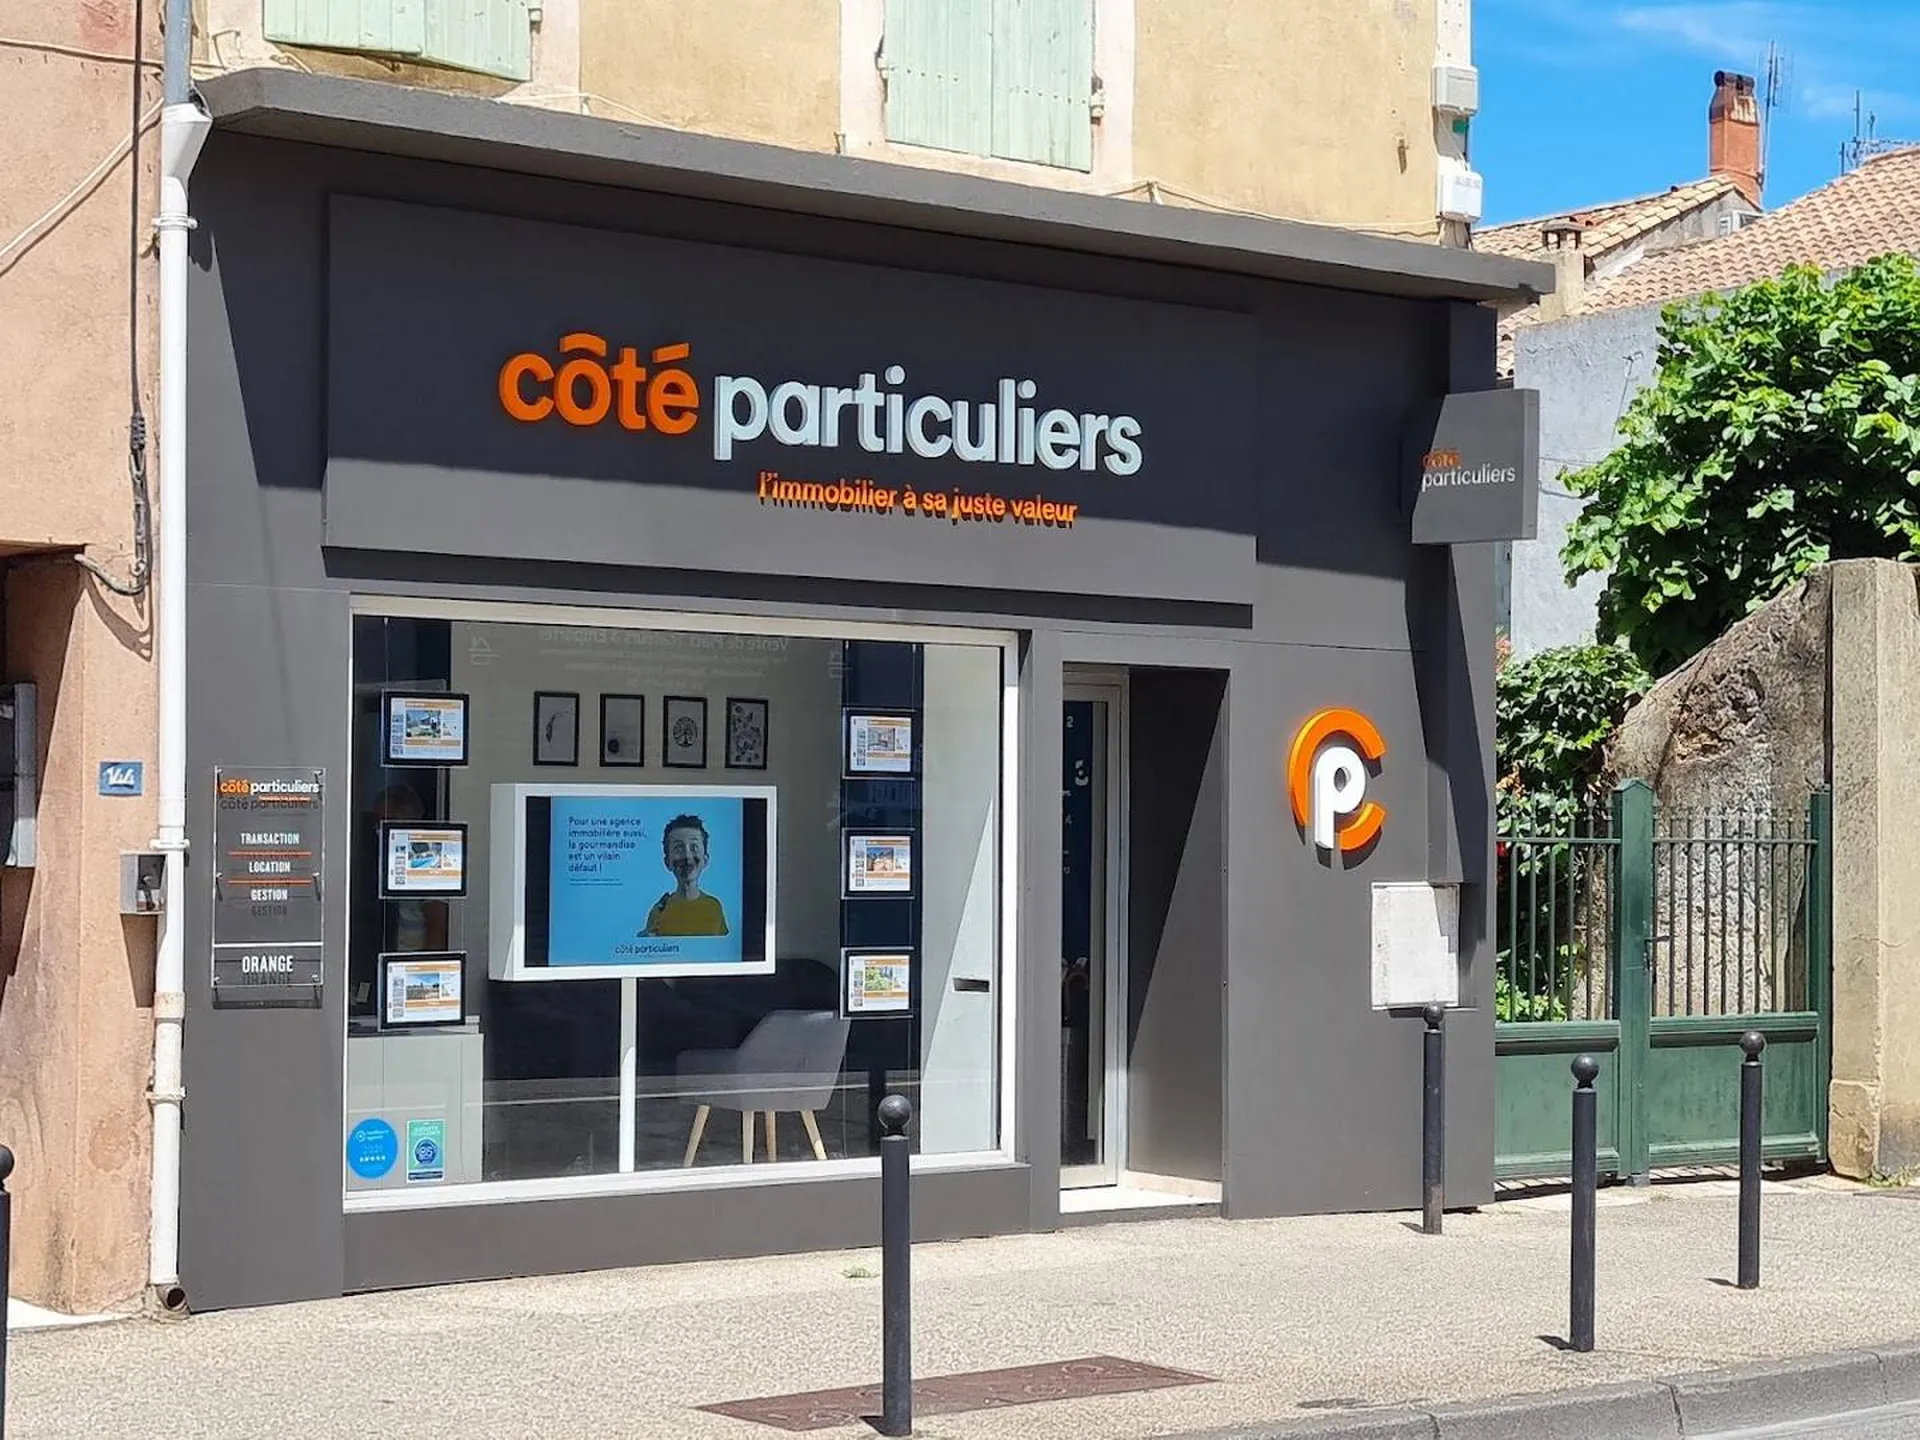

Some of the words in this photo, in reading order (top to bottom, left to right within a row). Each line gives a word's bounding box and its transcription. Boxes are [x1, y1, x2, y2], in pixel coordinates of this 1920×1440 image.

[499, 332, 700, 436] côté
[713, 365, 1143, 476] particuliers
[1421, 462, 1516, 492] particuliers
[758, 470, 898, 508] l'immobilier
[903, 484, 917, 509] à
[922, 491, 947, 512] sa
[952, 486, 1006, 518] juste
[1009, 494, 1077, 523] valeur
[220, 778, 249, 794] côté
[249, 779, 320, 797] particuliers
[568, 816, 588, 826] Pour
[610, 819, 641, 828] agence
[240, 832, 300, 845] TRANSACTION
[578, 840, 636, 851] gourmandise
[583, 852, 595, 860] un
[248, 861, 291, 873] LOCATION
[250, 888, 288, 901] GESTION
[242, 955, 294, 973] ORANGE
